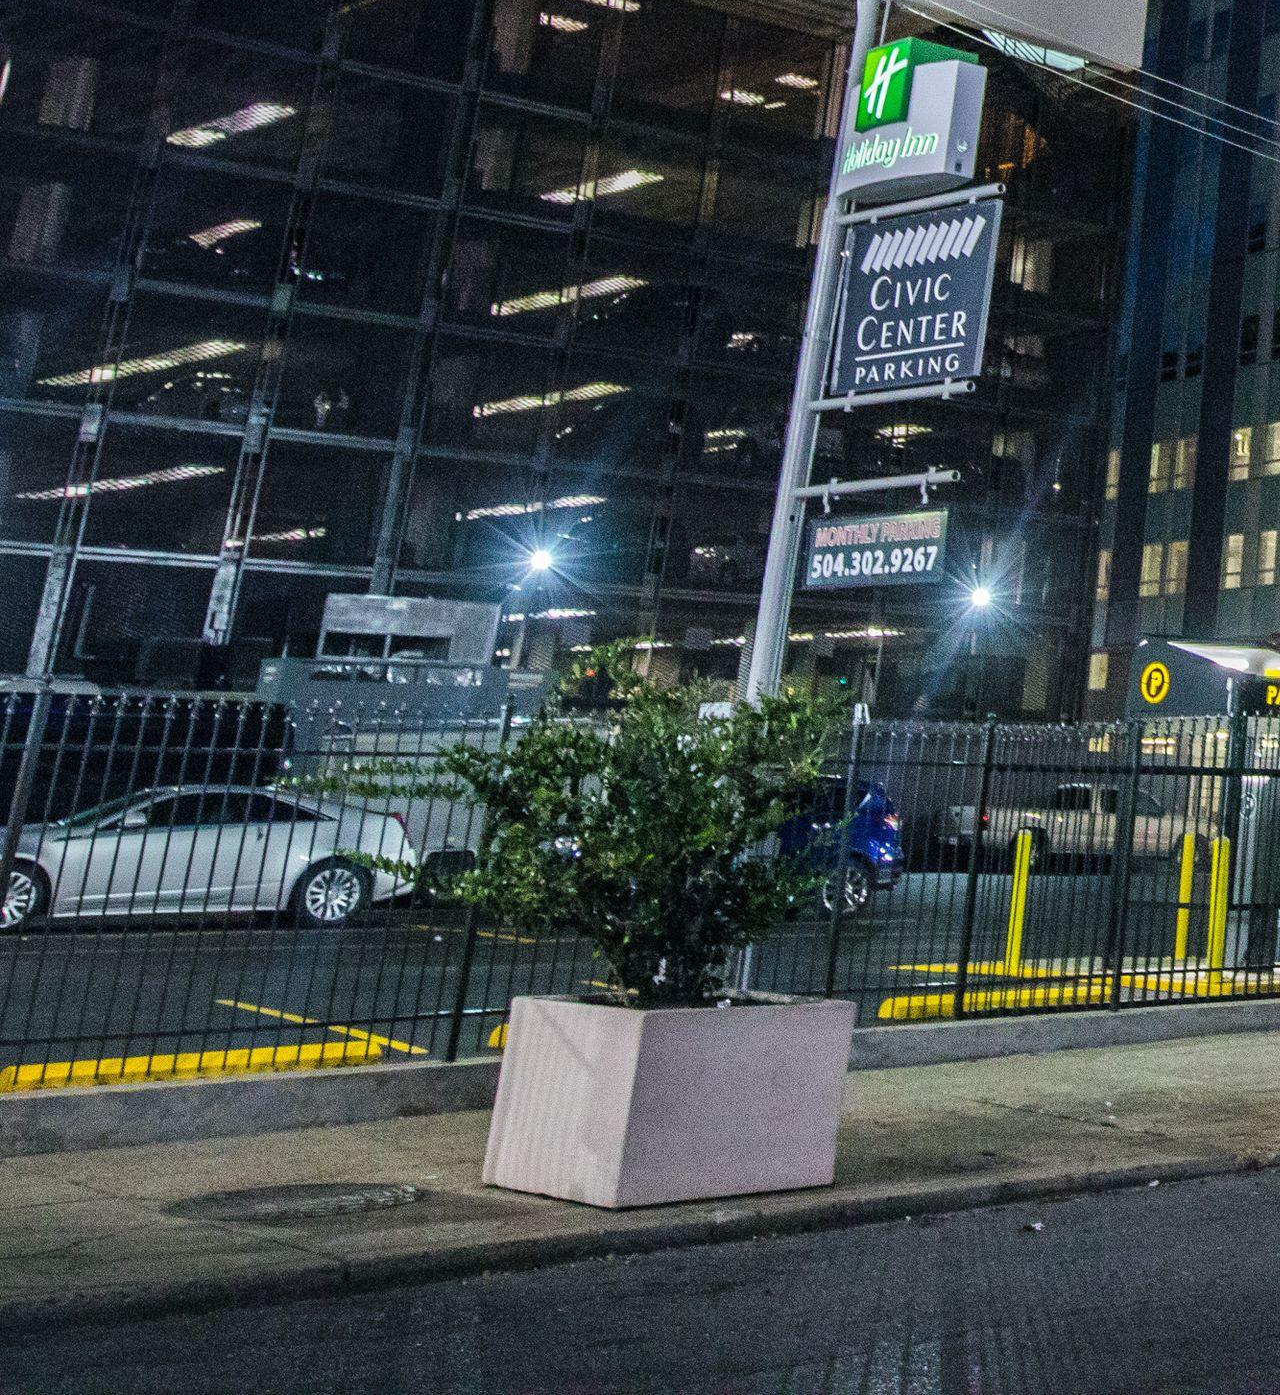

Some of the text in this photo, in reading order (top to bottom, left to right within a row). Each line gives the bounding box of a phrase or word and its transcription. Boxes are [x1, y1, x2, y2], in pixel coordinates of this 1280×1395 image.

[843, 127, 939, 175] Holiday Inn
[870, 273, 952, 311] CIVIC
[857, 310, 967, 351] CENTER
[855, 353, 960, 385] PARKING
[815, 517, 941, 548] MONTHLY PARKING
[811, 545, 938, 579] 504.302.9267
